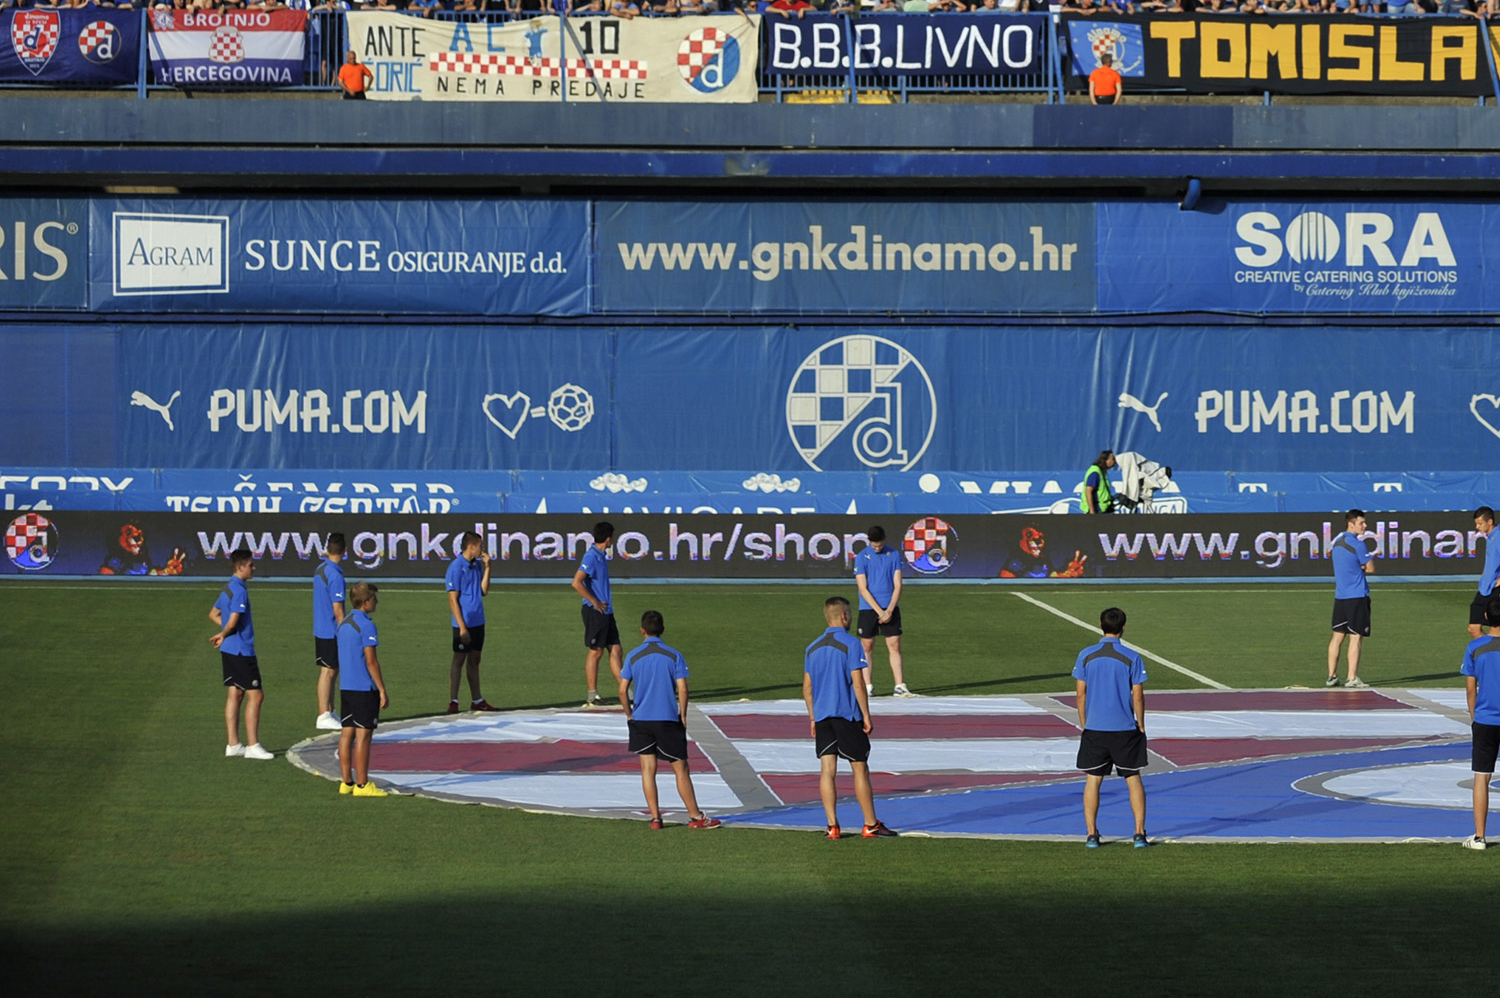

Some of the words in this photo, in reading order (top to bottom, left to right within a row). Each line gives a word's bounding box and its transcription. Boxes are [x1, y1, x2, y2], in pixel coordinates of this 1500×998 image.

[183, 13, 271, 27] BROTNJO
[579, 20, 620, 55] 10
[364, 25, 426, 58] ANTE
[161, 65, 293, 83] HERCEGOVINA
[437, 76, 505, 96] NEMA
[532, 79, 646, 100] PREDAJE
[0, 221, 79, 281] IS®
[244, 238, 382, 272] SUNCE
[388, 250, 527, 279] OSIGURANJE
[530, 250, 568, 274] d.d.
[616, 224, 1078, 282] www.gnkdinamo.hr
[1234, 211, 1458, 268] SORA
[1234, 270, 1301, 283] CREATIVE
[1304, 270, 1374, 283] CATERING
[1377, 270, 1458, 283] SOLUTIONS
[1305, 283, 1355, 301] Catering
[1357, 283, 1390, 297] Klub
[207, 389, 427, 434] PUMA.COM
[1194, 389, 1416, 434] PUMA.COM
[197, 522, 872, 570] wwwgnkdinao.hr/shop
